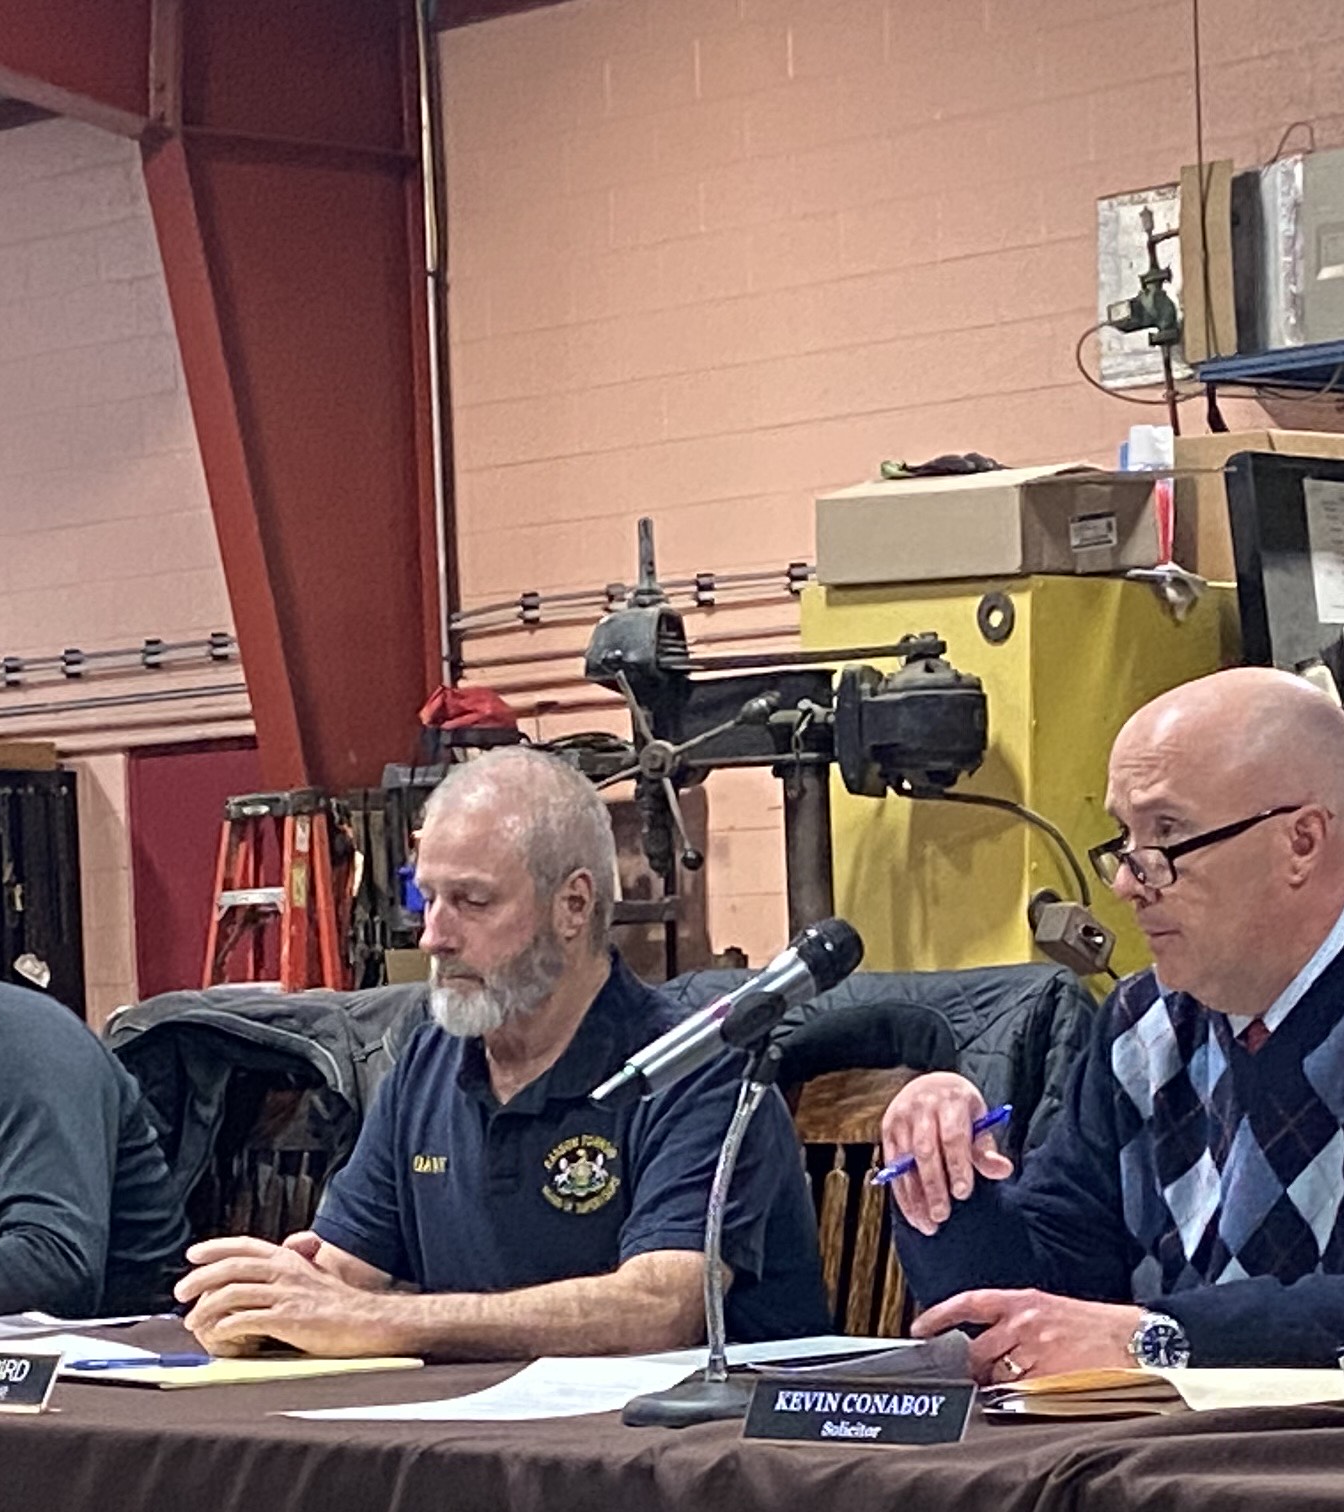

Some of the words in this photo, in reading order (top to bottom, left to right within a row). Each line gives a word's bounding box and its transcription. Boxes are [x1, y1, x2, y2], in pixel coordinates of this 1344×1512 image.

[774, 1391, 841, 1413] KEVIN
[842, 1393, 946, 1417] CONABOY
[820, 1420, 882, 1439] Solicitor
